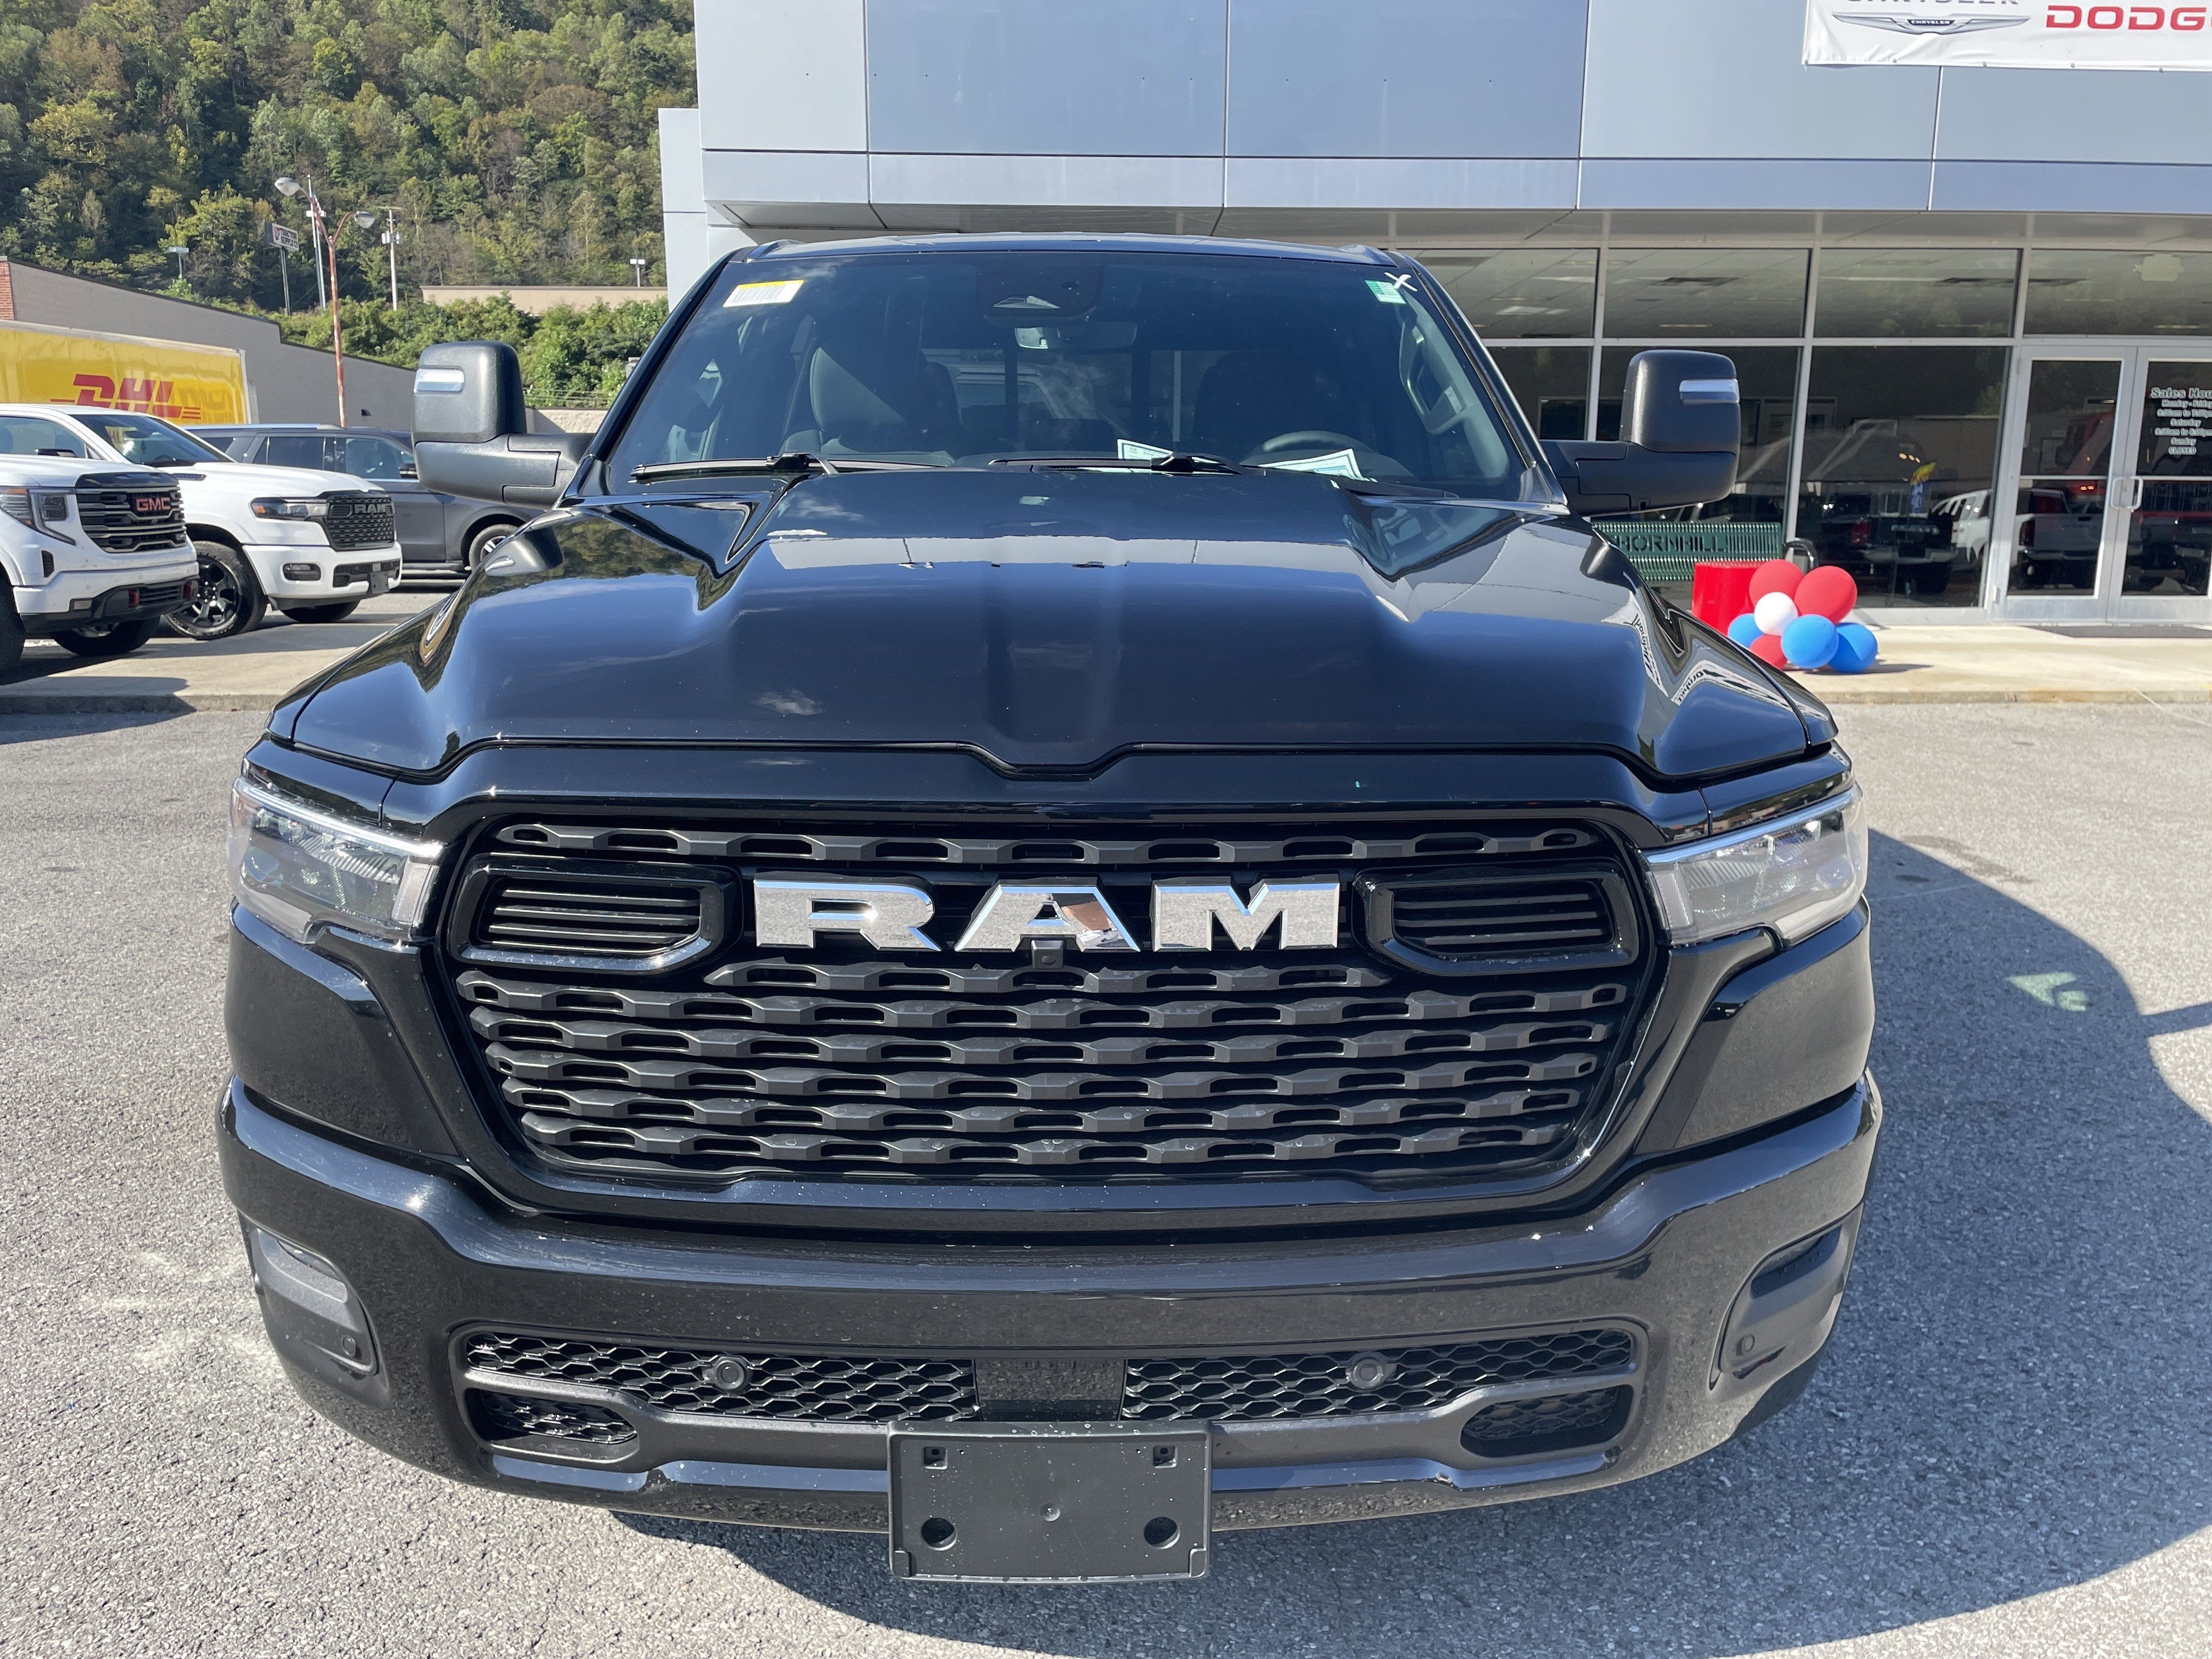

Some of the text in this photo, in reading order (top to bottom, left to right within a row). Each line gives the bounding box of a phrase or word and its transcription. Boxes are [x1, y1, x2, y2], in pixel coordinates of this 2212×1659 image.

[2046, 5, 2212, 30] DODG
[74, 374, 182, 418] DHL
[2151, 387, 2186, 398] Sales
[136, 497, 171, 511] GMC
[354, 504, 386, 514] RAM
[1613, 532, 1726, 552] HORNHILL
[753, 878, 1340, 952] RAM
